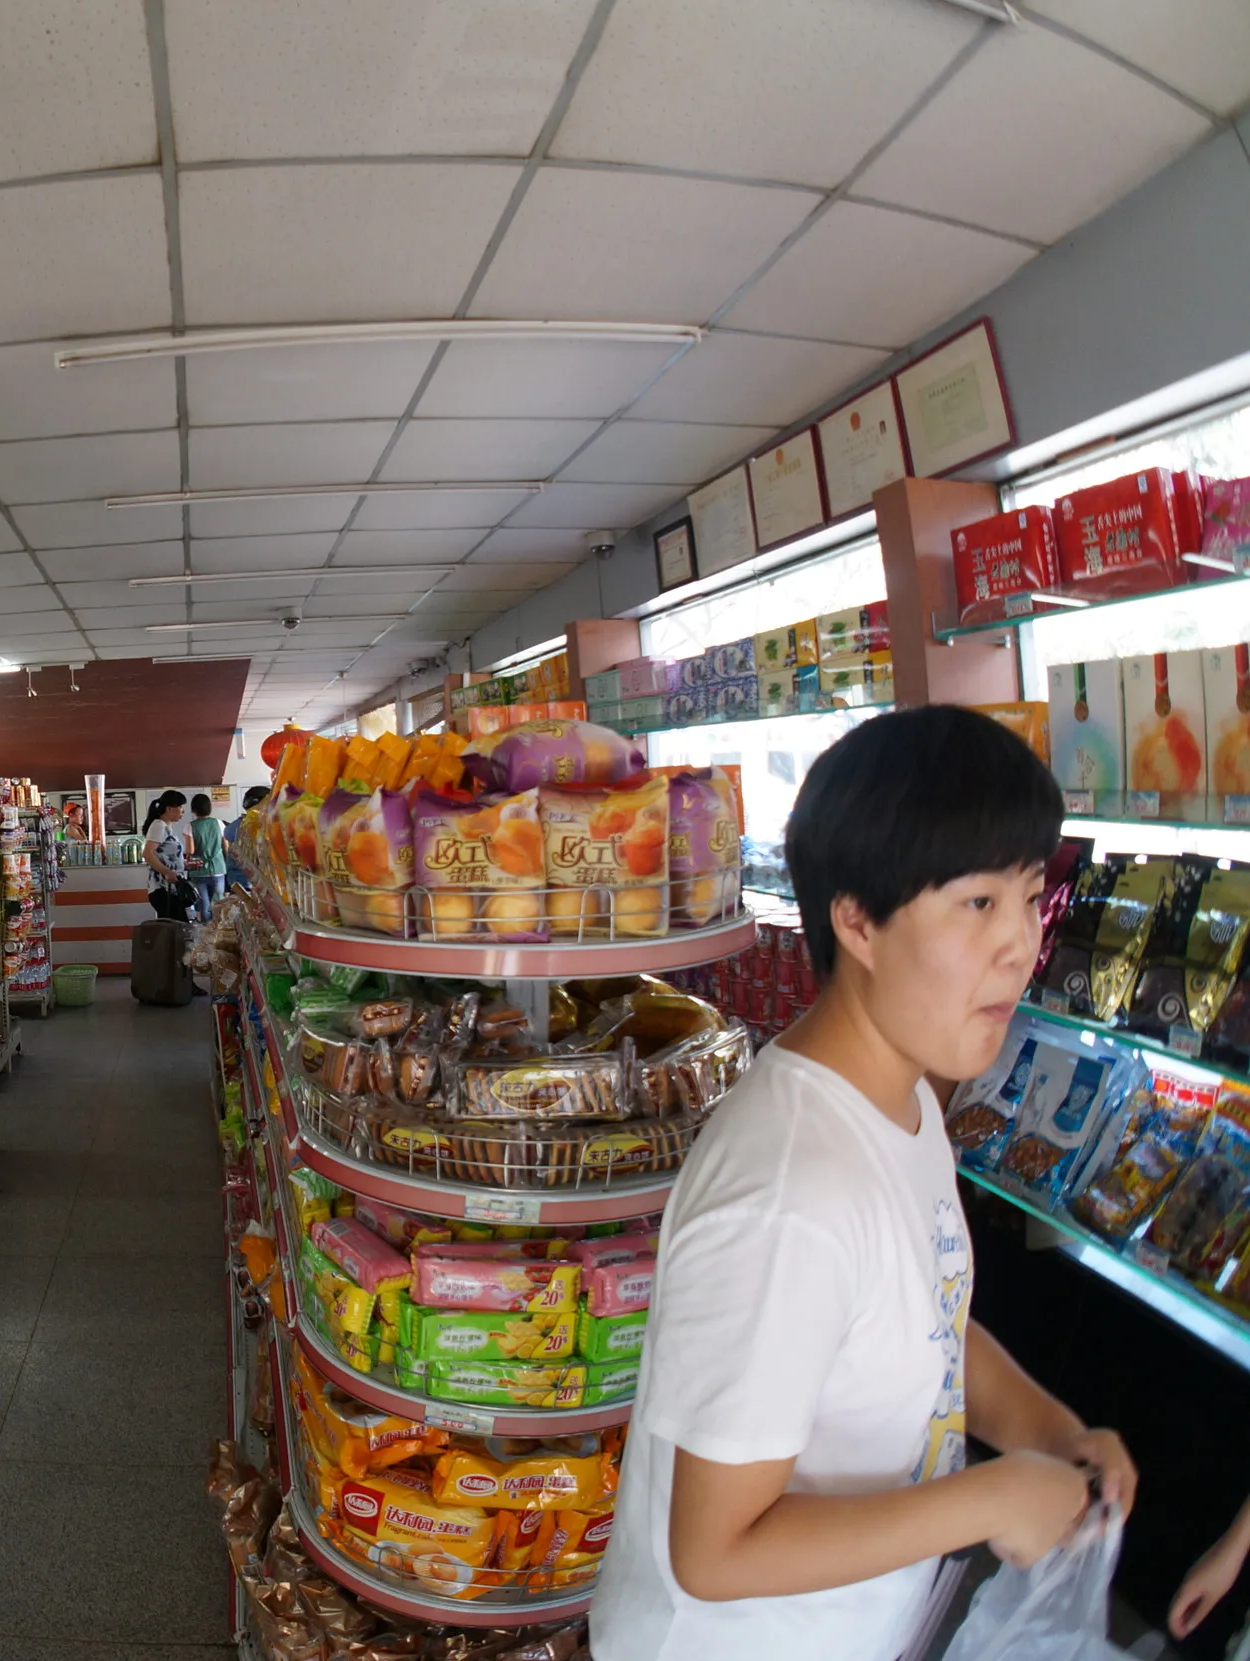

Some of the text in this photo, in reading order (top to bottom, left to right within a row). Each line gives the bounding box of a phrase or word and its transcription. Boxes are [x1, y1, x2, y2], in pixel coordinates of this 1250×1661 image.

[424, 834, 495, 869] 欧式
[552, 834, 625, 867] 欧式
[447, 866, 490, 883] 蛋糕
[574, 867, 618, 884] 蛋糕
